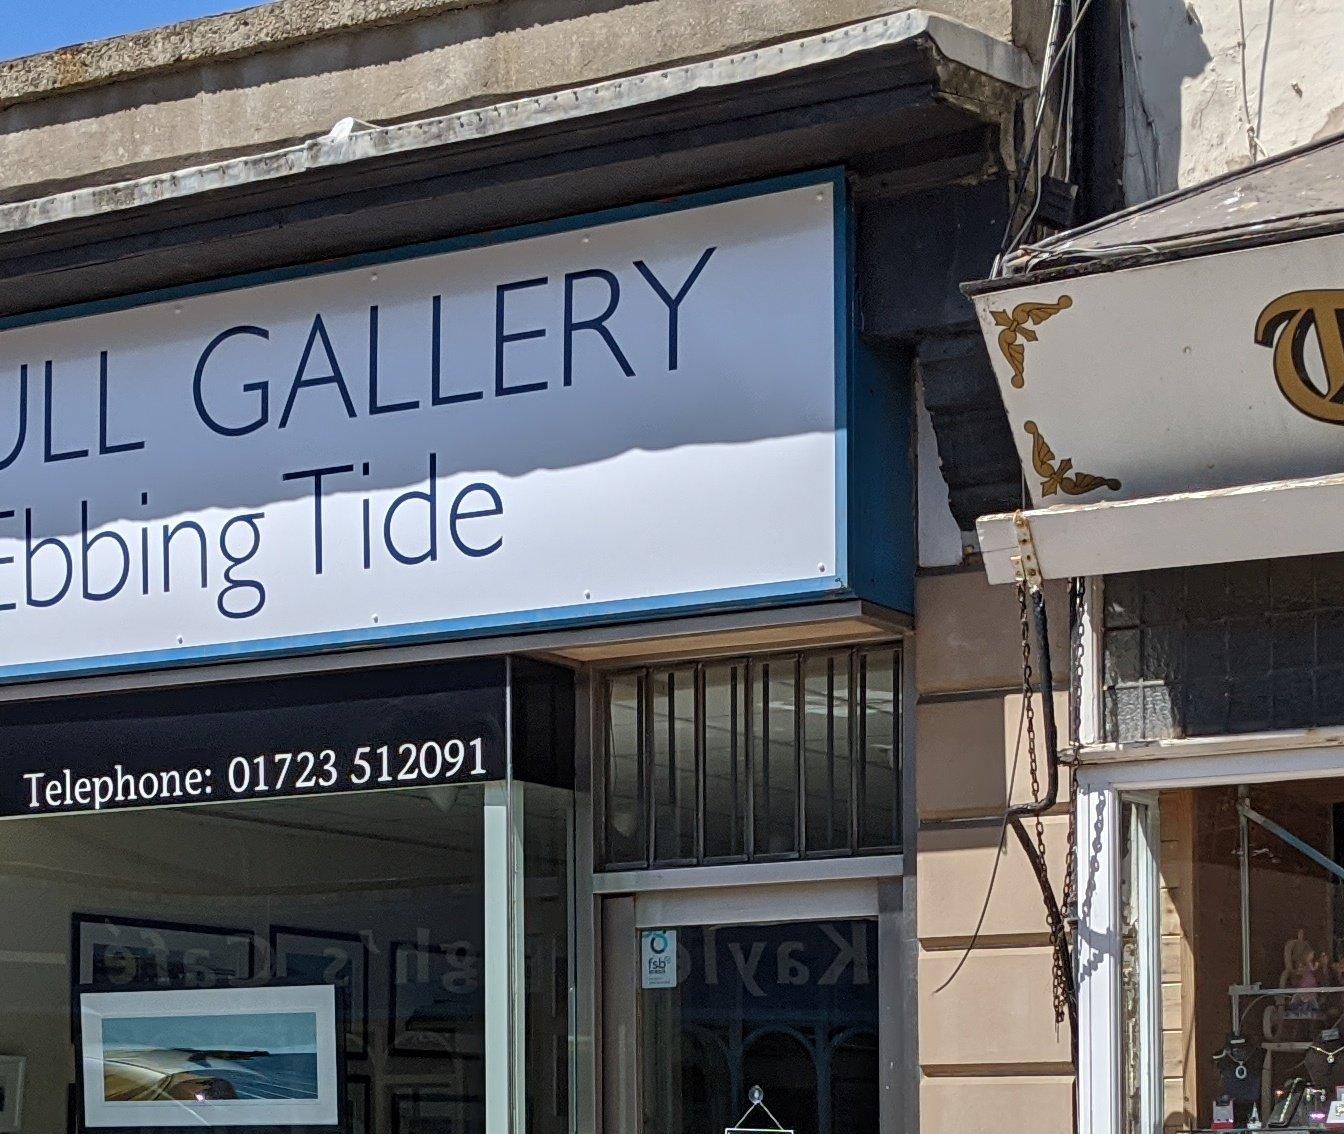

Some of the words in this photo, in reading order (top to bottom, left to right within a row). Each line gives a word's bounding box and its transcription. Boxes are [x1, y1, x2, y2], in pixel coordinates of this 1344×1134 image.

[193, 247, 717, 436] GALLERY
[282, 453, 503, 574] Tide
[23, 764, 213, 810] Telephone:
[228, 749, 338, 793] 01723
[350, 737, 488, 784] 512091
